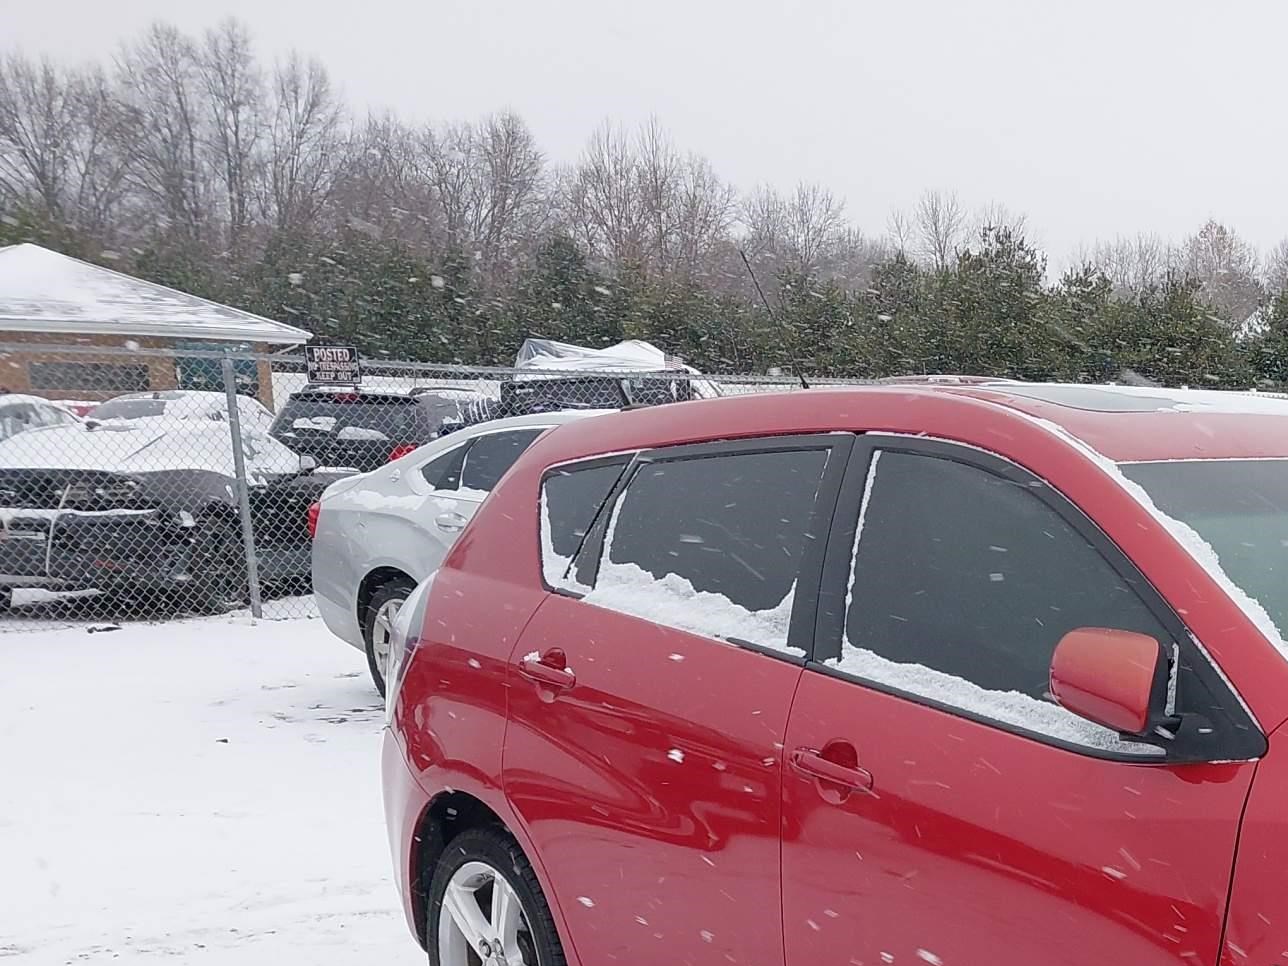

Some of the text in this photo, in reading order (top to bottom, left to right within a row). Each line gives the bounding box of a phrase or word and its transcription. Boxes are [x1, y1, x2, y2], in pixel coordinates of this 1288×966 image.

[313, 348, 350, 361] POSTED
[316, 371, 352, 380] KEEP OUT
